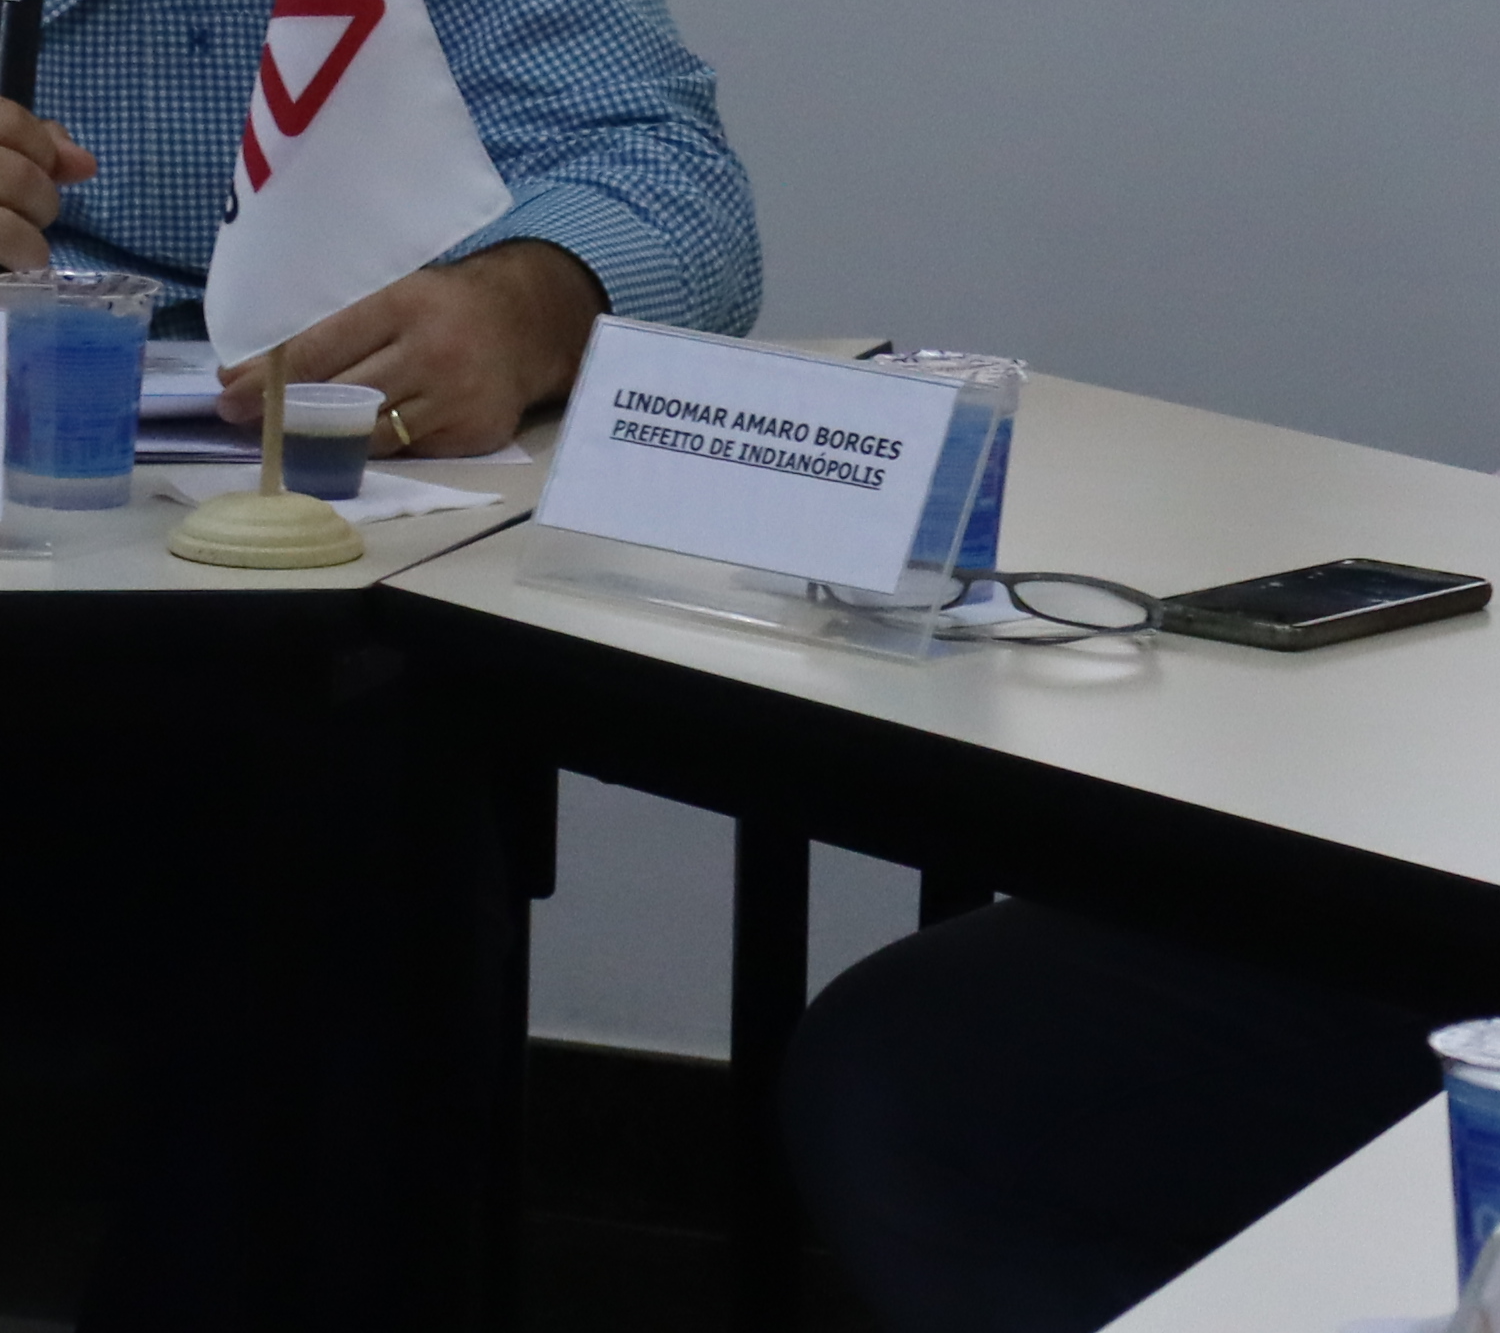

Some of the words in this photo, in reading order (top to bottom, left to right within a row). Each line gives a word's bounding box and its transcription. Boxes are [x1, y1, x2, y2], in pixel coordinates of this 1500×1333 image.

[612, 419, 704, 452] PREFEITO
[709, 437, 735, 459] DE
[738, 442, 886, 487] INDIANÓPOLIS
[613, 389, 728, 428] LINDOMAR
[731, 411, 810, 443] AMARO
[813, 426, 903, 461] BORGES
